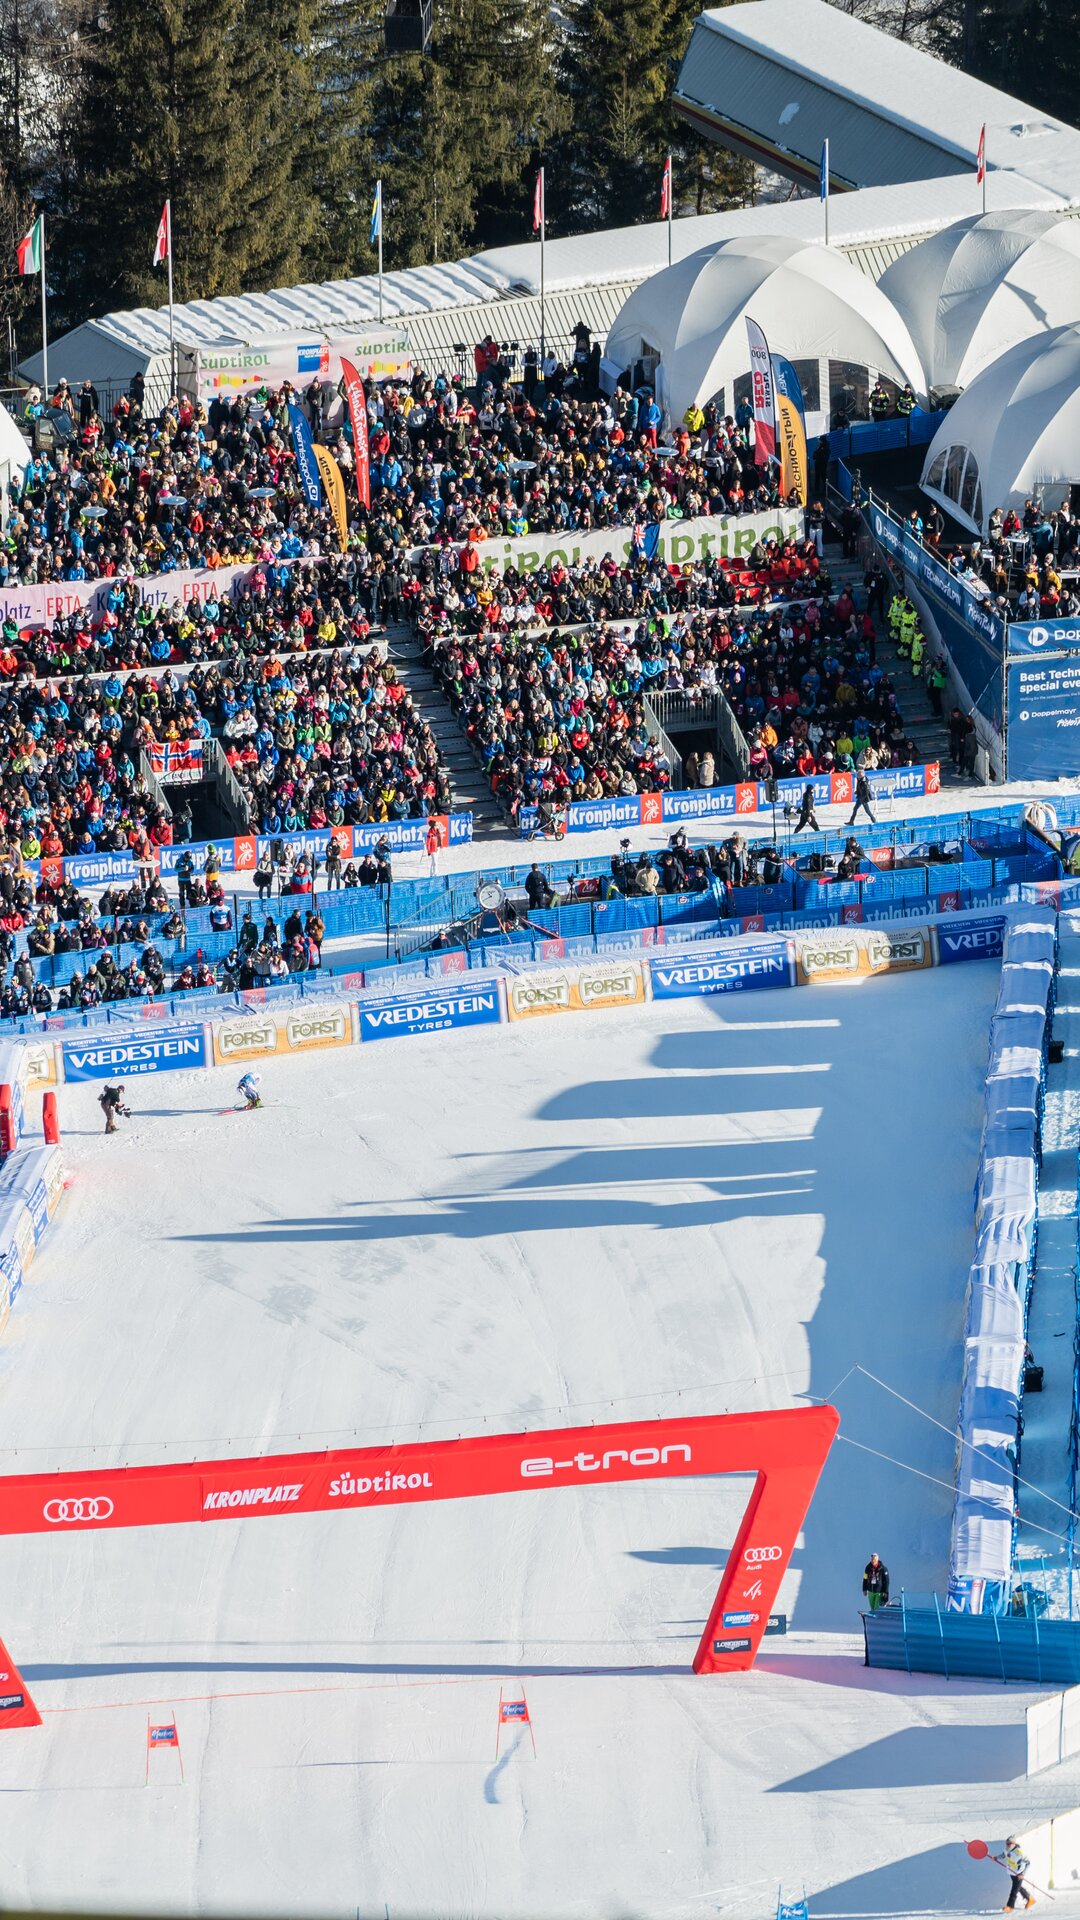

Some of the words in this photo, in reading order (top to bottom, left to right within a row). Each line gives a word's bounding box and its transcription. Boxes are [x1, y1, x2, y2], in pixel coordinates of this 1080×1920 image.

[183, 581, 219, 602] ERTA
[1020, 671, 1046, 682] Best
[1020, 680, 1060, 694] special
[1031, 708, 1077, 718] Doppelmayr
[663, 793, 734, 816] Kronplatz
[569, 803, 639, 827] Kronplatz
[65, 857, 136, 881] Kronplatz
[806, 949, 855, 968] FORST
[873, 941, 921, 960] FORST
[656, 956, 783, 987] VREDESTEIN
[517, 985, 564, 1005] FORST
[584, 976, 632, 996] FORST
[698, 981, 744, 993] TYRES
[365, 994, 494, 1028] VREDESTEIN
[292, 1018, 340, 1038] FORST
[408, 1020, 453, 1032] TYRES
[224, 1028, 272, 1048] FORST
[68, 1038, 201, 1069] VREDESTEIN
[112, 1062, 158, 1075] TYRES
[520, 1444, 692, 1478] e-tron
[203, 1484, 304, 1510] KRONPLATZ
[716, 1639, 749, 1649] LONGINES
